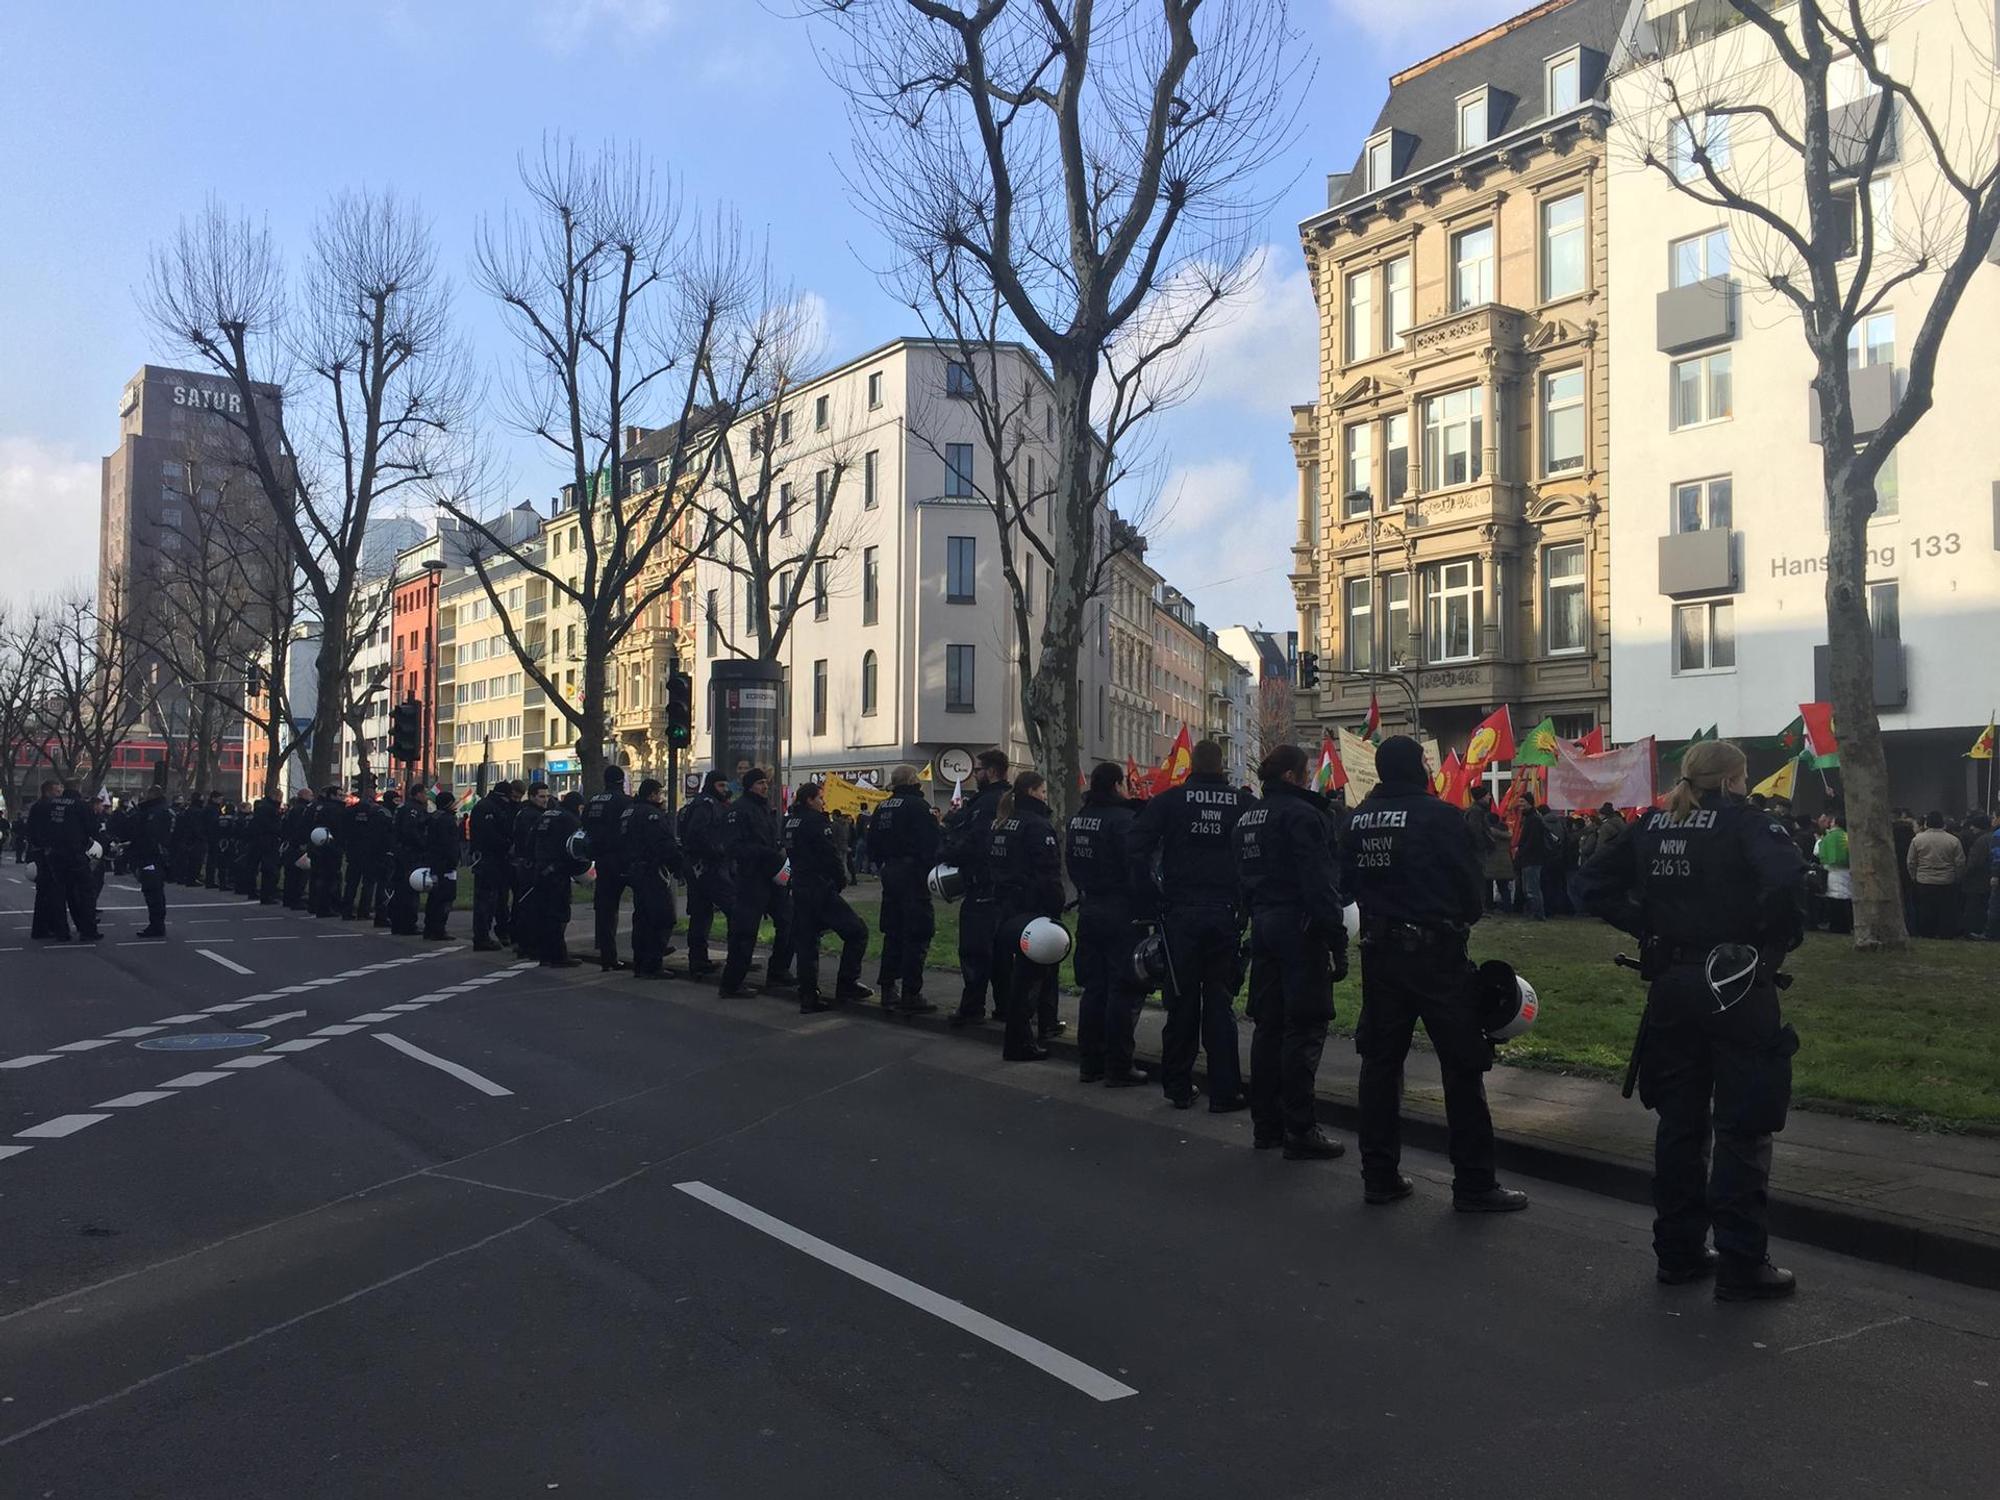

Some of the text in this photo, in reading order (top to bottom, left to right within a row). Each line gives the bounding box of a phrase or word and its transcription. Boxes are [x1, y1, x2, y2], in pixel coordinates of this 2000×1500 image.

[173, 386, 242, 414] SATUR
[1771, 532, 1961, 578] Hansng 133
[1186, 790, 1237, 805] POLIZEI
[1201, 809, 1222, 821] NRW
[1237, 809, 1268, 827] POLIZEI
[1350, 810, 1408, 831] POLIZEI
[1647, 809, 1718, 831] POLIZEI
[990, 818, 1020, 832] PZEI
[1070, 817, 1101, 831] POLIZEI
[1191, 821, 1221, 835] 21613
[1361, 836, 1393, 852] NRW
[1659, 839, 1688, 855] NRW
[1356, 852, 1392, 868] 21633
[1651, 858, 1691, 877] 21613
